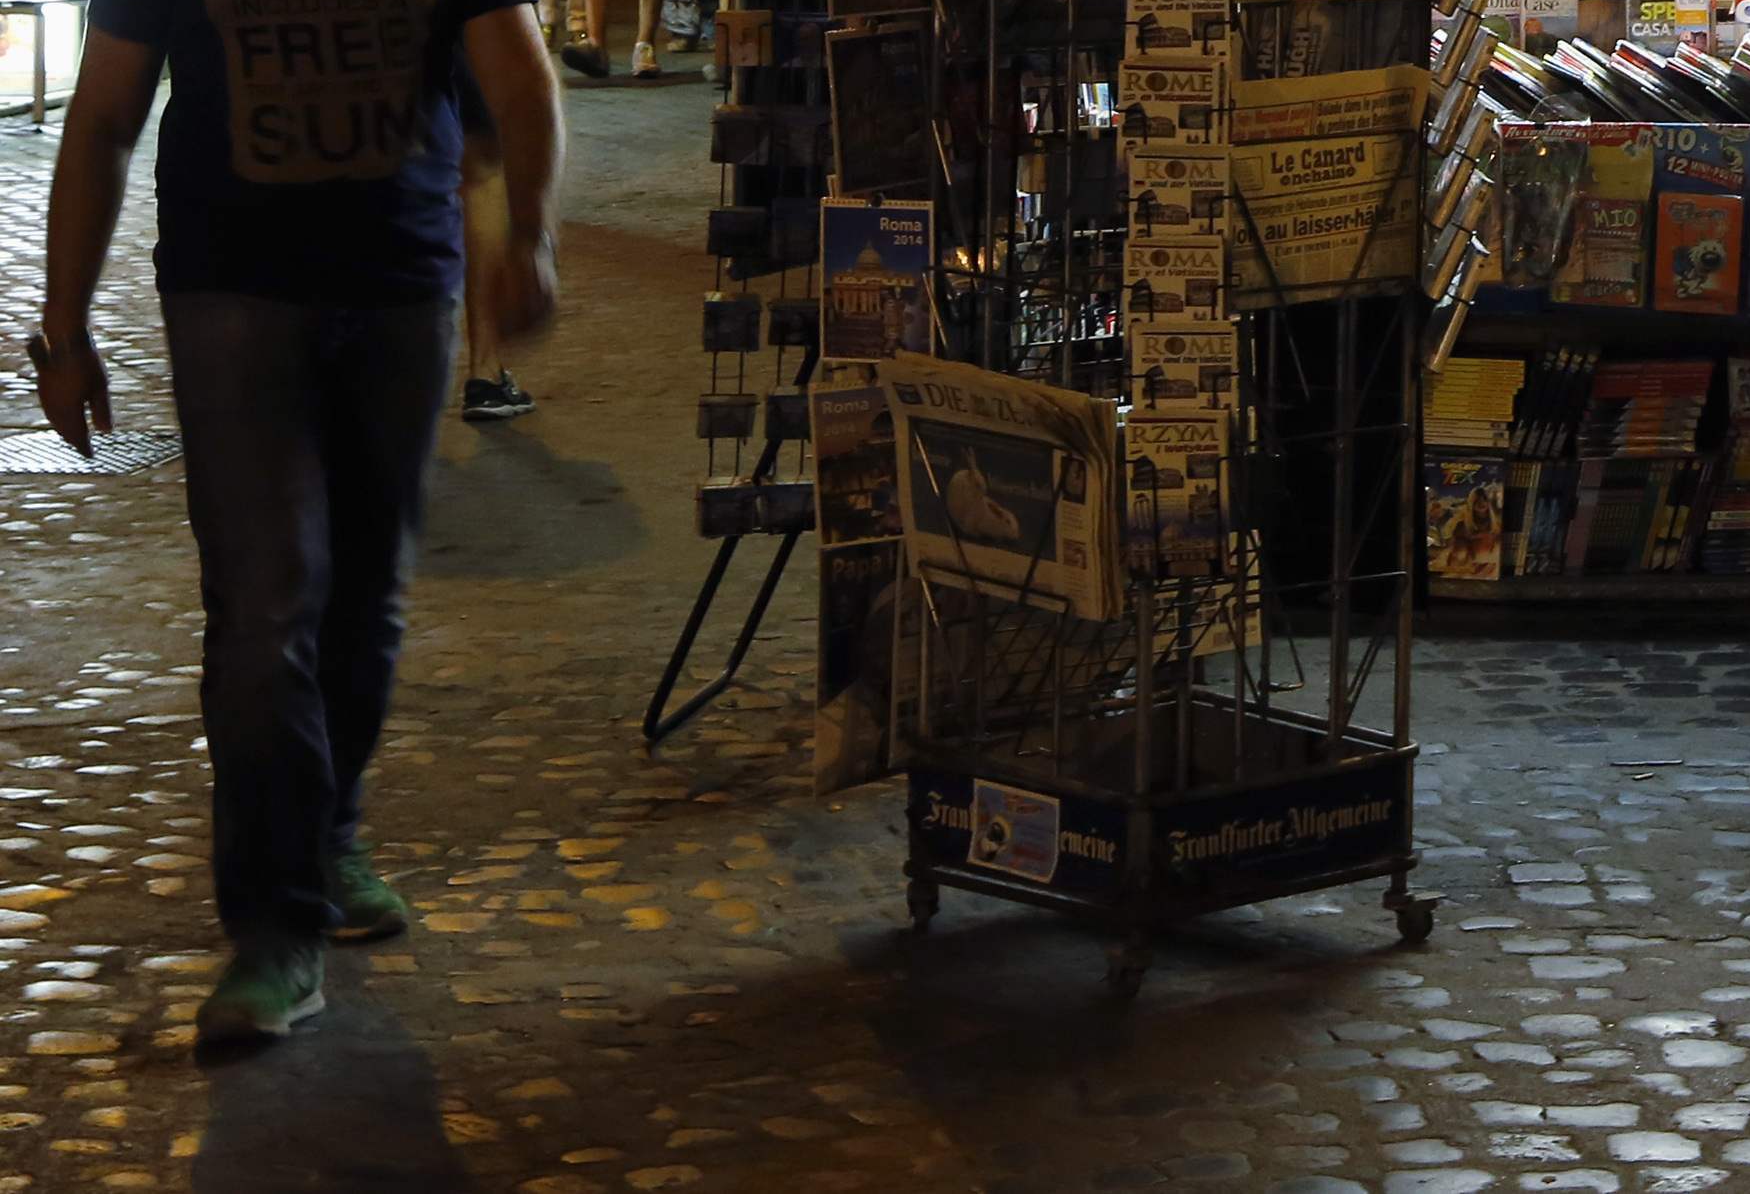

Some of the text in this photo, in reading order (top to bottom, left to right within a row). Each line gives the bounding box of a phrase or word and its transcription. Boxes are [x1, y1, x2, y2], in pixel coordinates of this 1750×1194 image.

[1639, 1, 1676, 21] SPE
[1631, 22, 1671, 37] CASA
[234, 17, 413, 79] FREE
[1123, 72, 1213, 93] ROME
[250, 99, 417, 165] SUN
[1271, 142, 1366, 174] Le Canard
[1666, 155, 1687, 174] 12
[1145, 160, 1217, 180] ROM
[880, 216, 923, 231] Roma
[1593, 209, 1638, 228] MIO
[894, 232, 924, 246] 2014
[1264, 223, 1288, 242] au
[1130, 249, 1218, 268] ROMA
[1142, 336, 1232, 356] ROME
[925, 382, 967, 411] DIE
[1130, 425, 1219, 444] RZYM
[1442, 470, 1477, 486] TEX
[1167, 798, 1394, 869] Frankfurter Allgemeine
[1060, 828, 1117, 864] emeine
